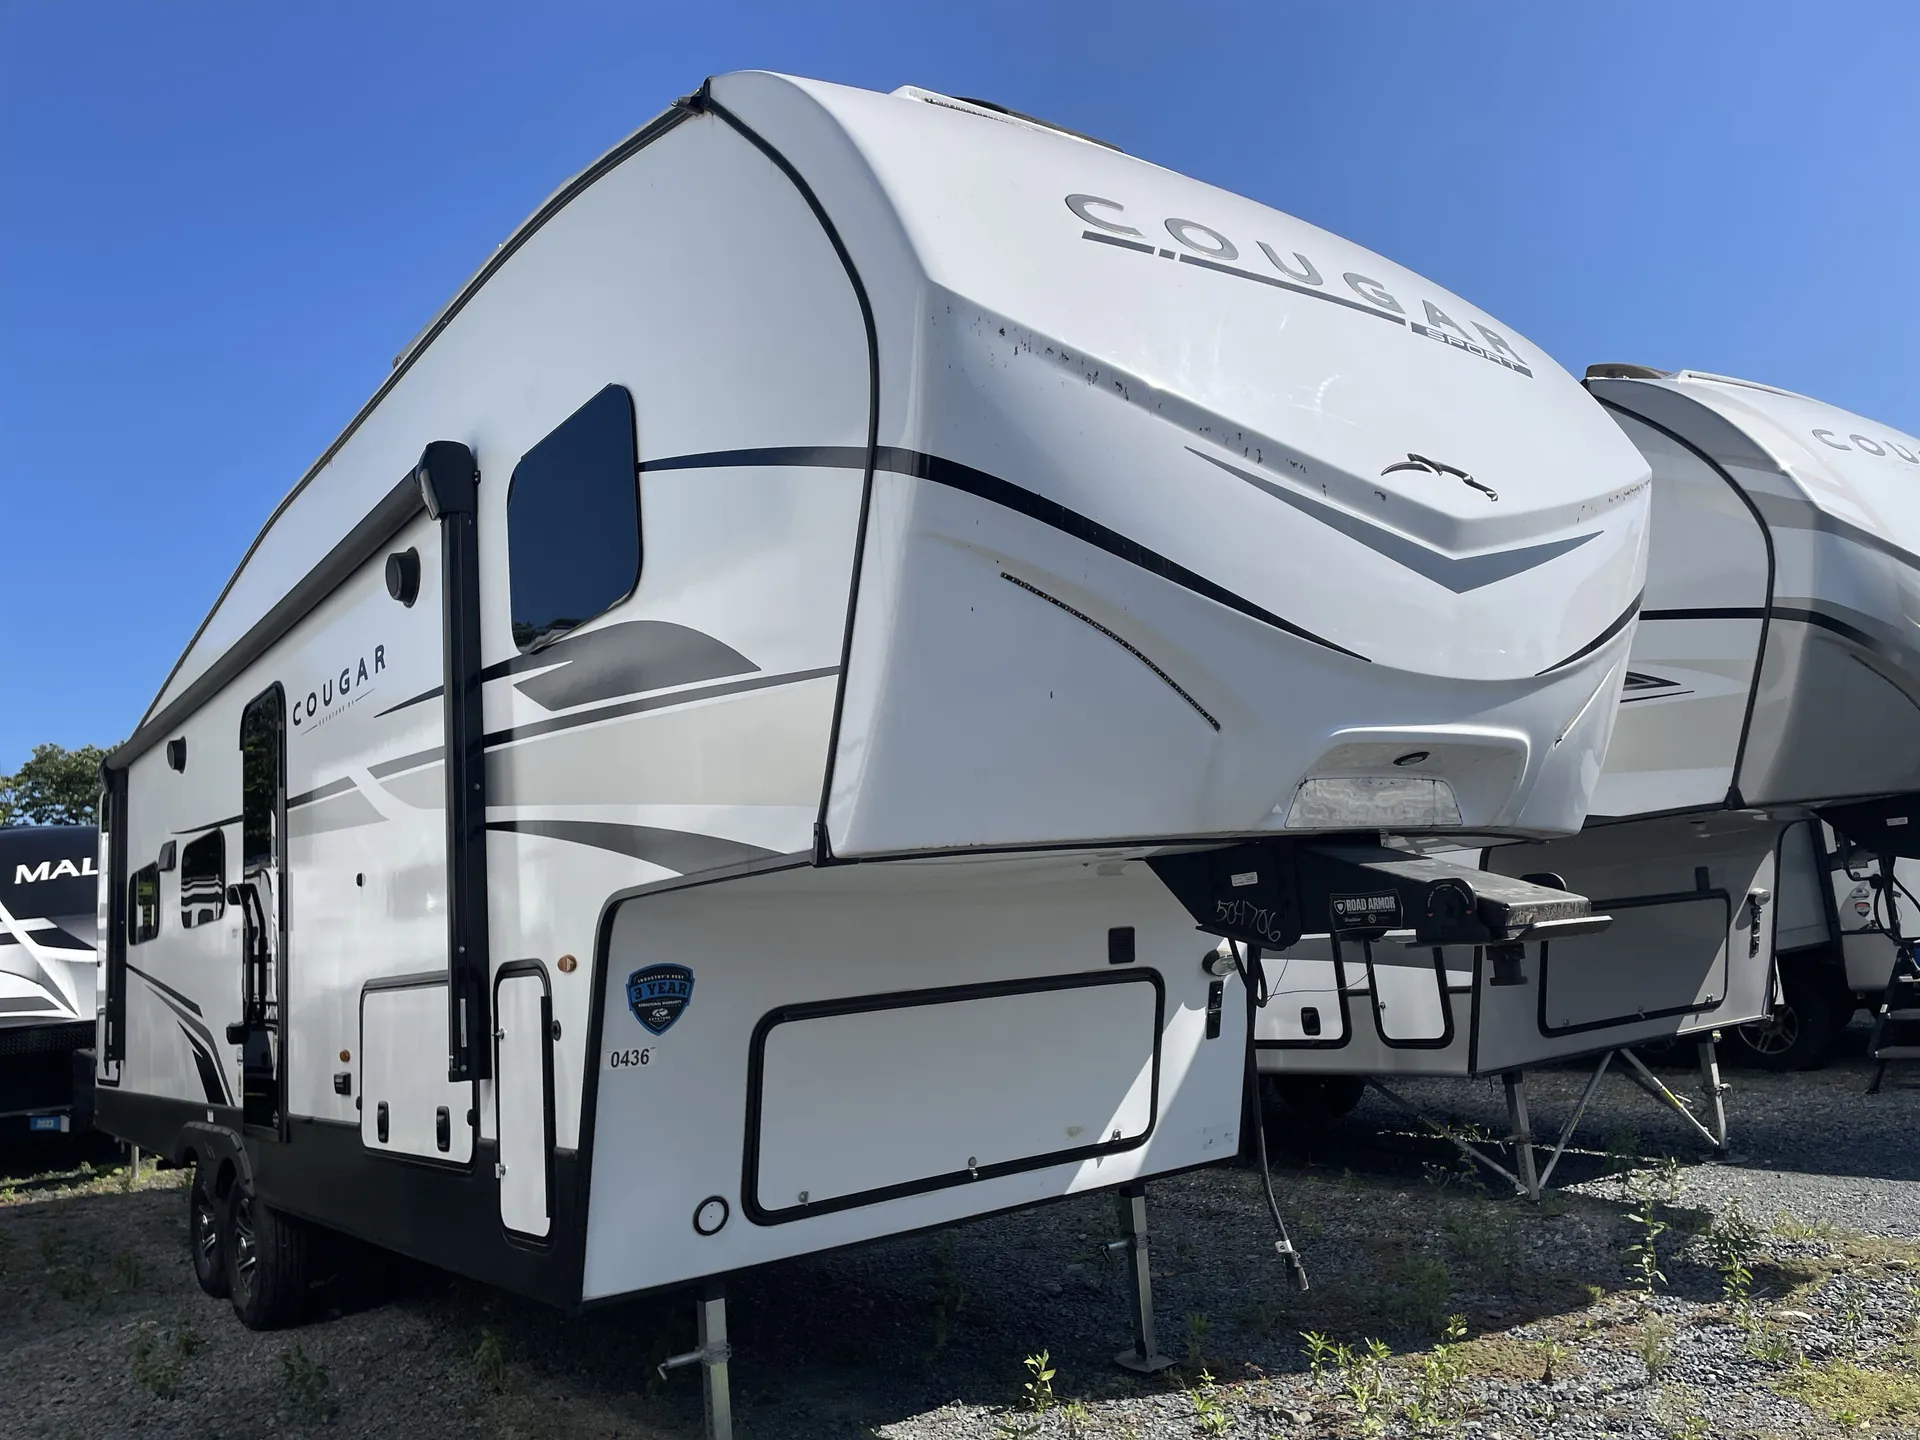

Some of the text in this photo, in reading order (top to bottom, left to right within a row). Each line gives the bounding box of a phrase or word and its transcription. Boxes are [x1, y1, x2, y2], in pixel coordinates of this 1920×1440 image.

[1064, 193, 1528, 366] COUGAR
[1425, 327, 1519, 371] SPORT
[1811, 428, 1920, 465] COU
[292, 644, 386, 727] COUGAR
[14, 857, 99, 885] MAL
[1346, 896, 1396, 911] ROAD ARMOR
[1215, 899, 1281, 942] 504706
[633, 981, 687, 1000] 3 YEAR
[637, 974, 670, 983] INDUSTRY'S
[610, 1048, 650, 1068] 0436
